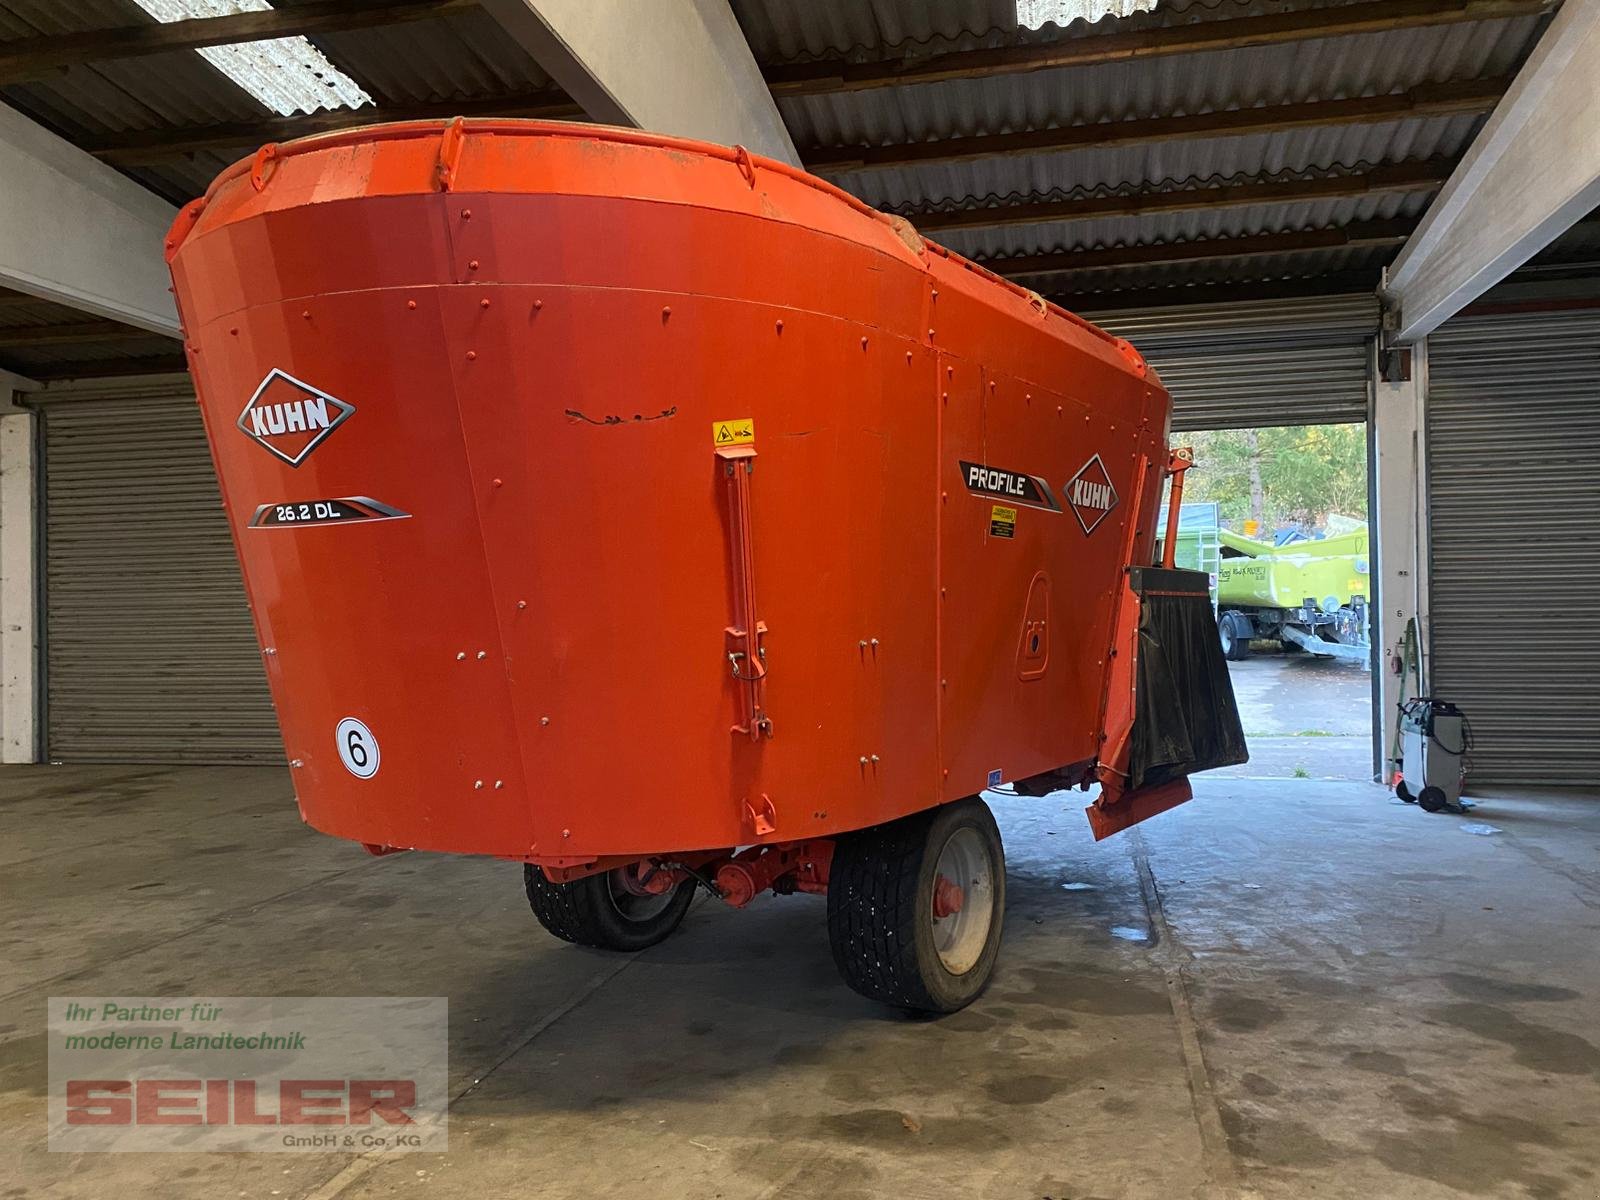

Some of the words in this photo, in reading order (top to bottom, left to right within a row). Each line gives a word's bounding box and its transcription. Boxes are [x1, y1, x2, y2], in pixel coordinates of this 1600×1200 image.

[250, 398, 330, 437] KUHN
[969, 466, 1026, 495] PROFILE
[1072, 478, 1111, 510] KUHN
[276, 505, 311, 522] 26.2
[315, 502, 340, 518] DL
[347, 730, 368, 767] 6
